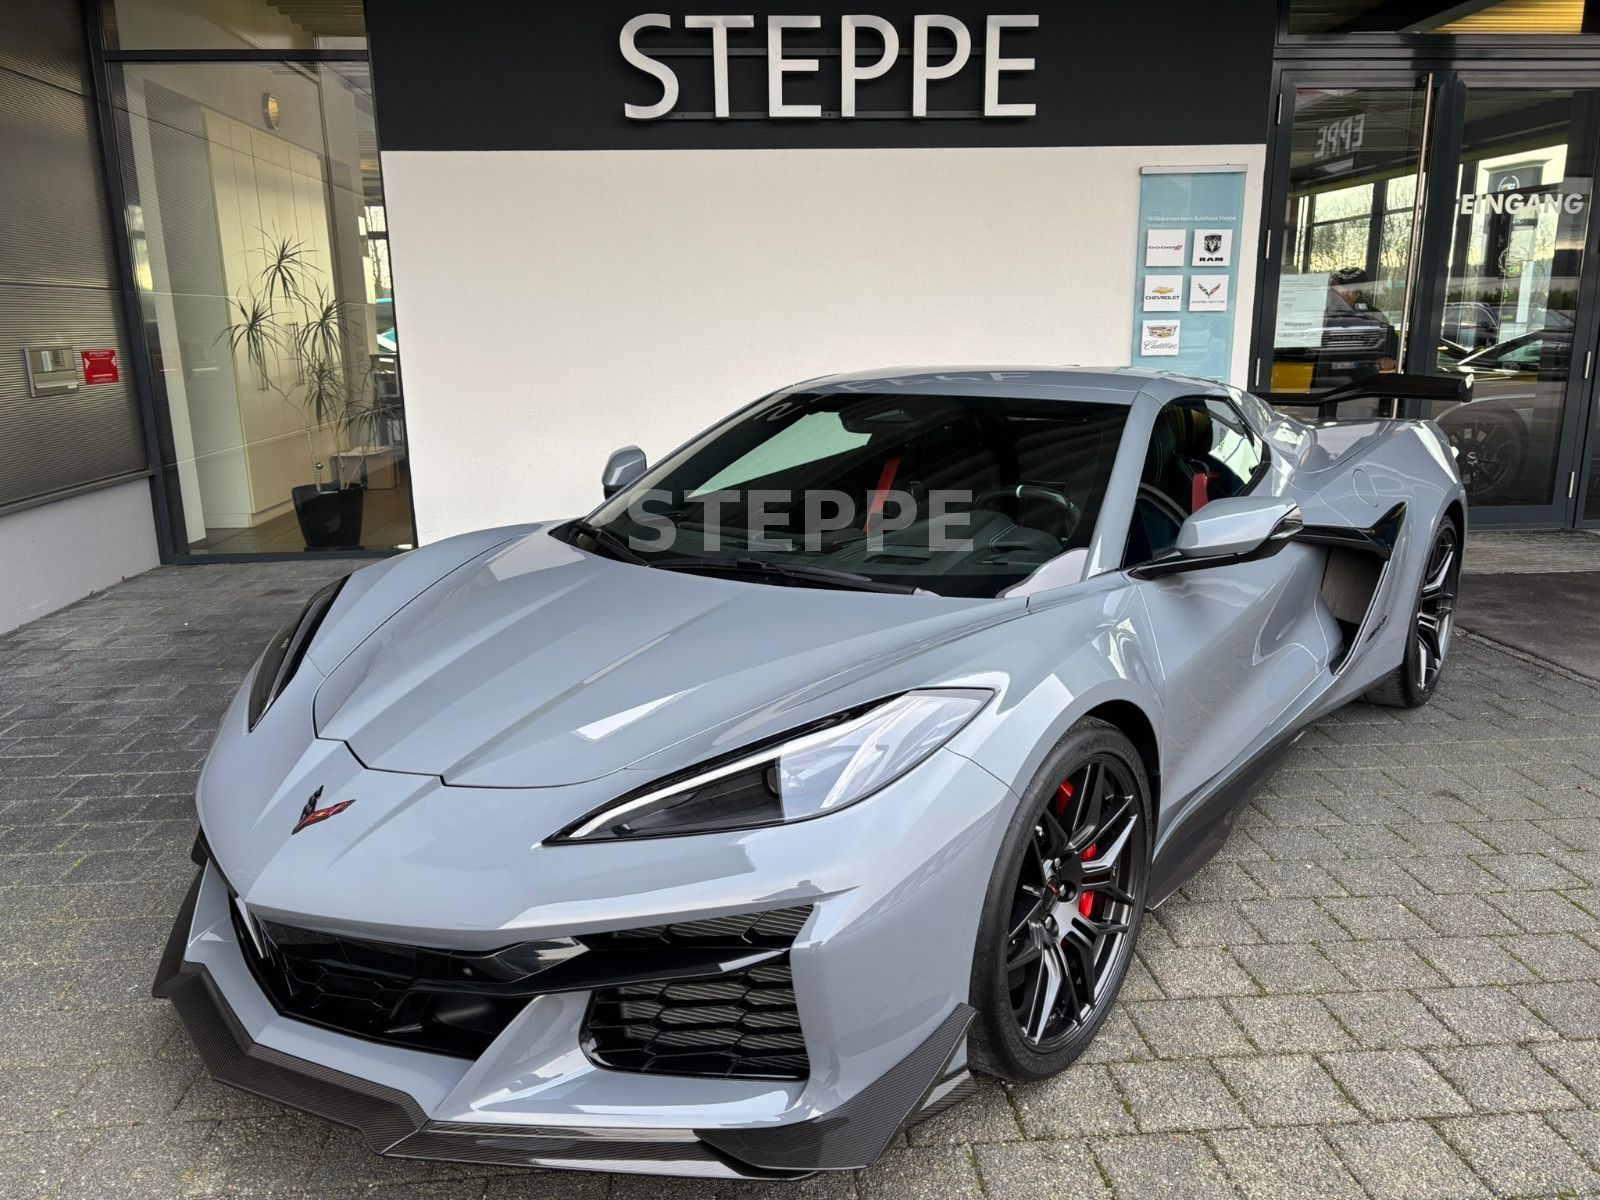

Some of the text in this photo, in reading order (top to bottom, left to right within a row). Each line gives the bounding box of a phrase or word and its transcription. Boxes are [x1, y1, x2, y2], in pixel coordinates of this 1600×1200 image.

[619, 13, 1039, 119] STEPPE
[1461, 193, 1584, 214] EINGANG
[1143, 340, 1178, 350] Cadillac
